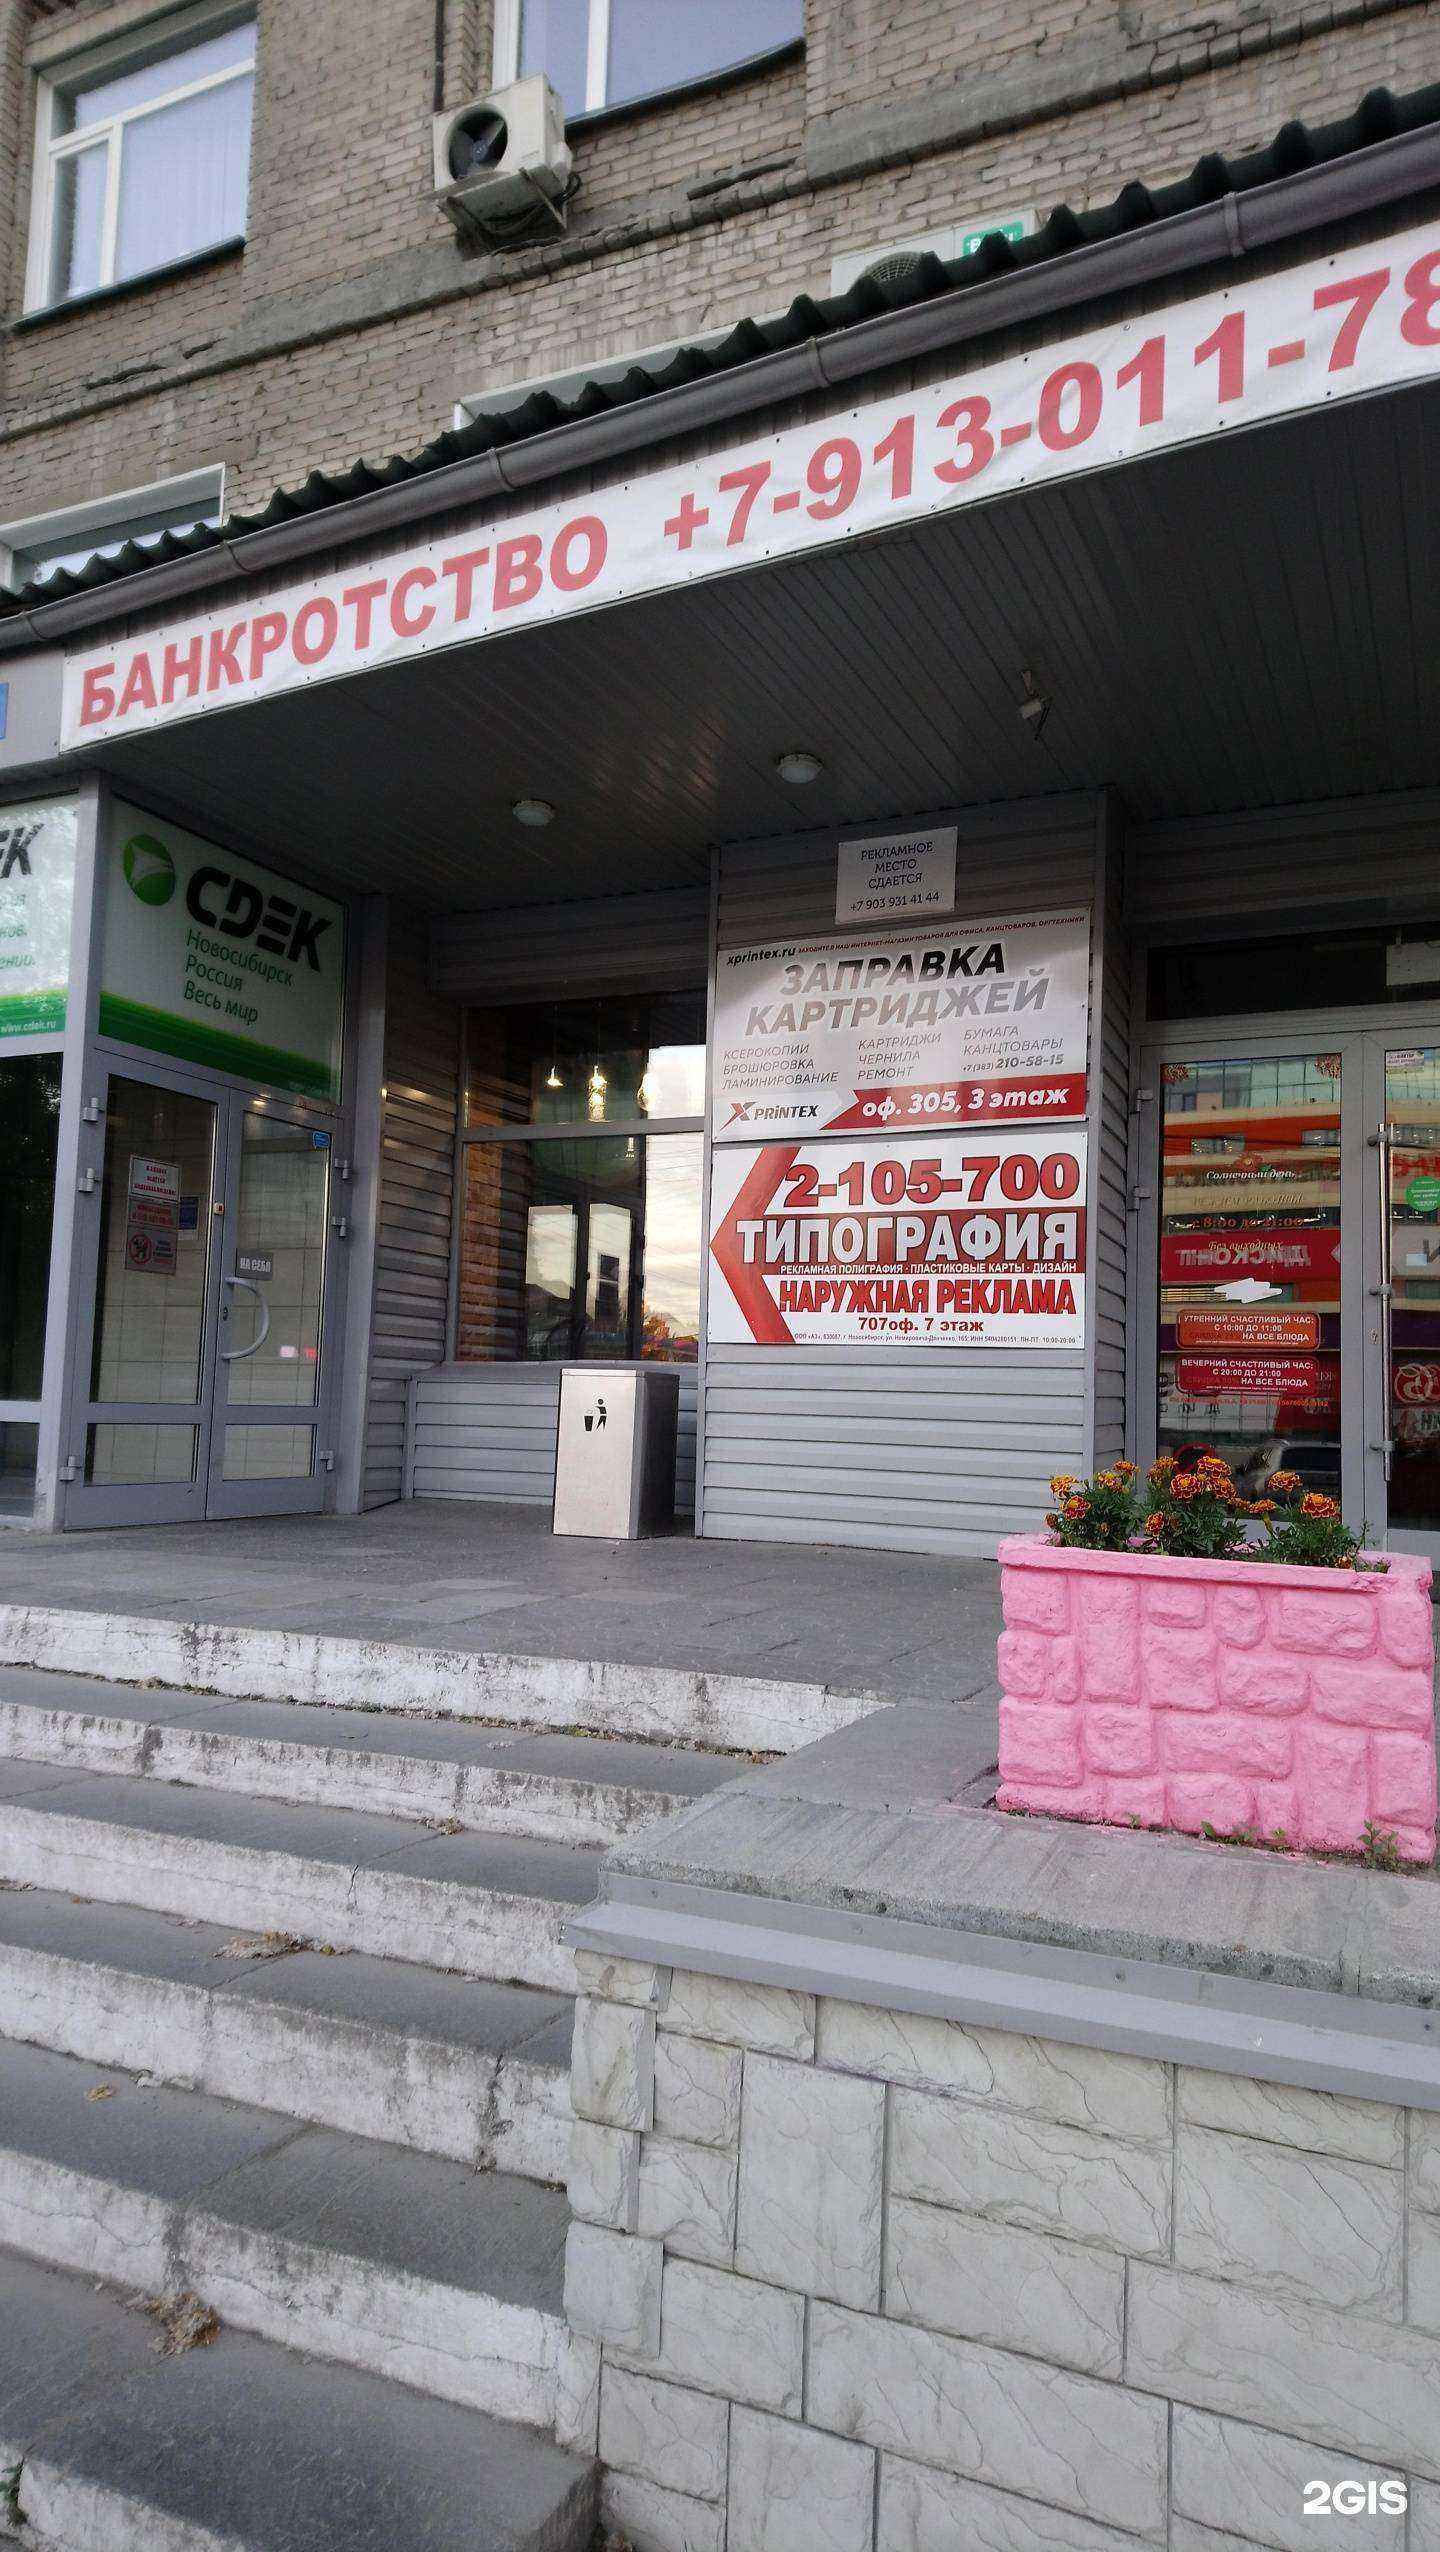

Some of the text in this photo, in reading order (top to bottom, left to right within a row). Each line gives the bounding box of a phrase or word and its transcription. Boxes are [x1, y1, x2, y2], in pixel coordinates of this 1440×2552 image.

[80, 516, 608, 727] БАНКРОТСТВО
[861, 842, 933, 860] РЕКЛАМНОЕ
[875, 859, 917, 873] МЕСТО
[869, 873, 922, 889] СДАЕТСЯ
[851, 892, 940, 911] +7 903 931 41 44
[186, 866, 332, 972] CDEK
[186, 928, 295, 987] Новосибирск
[727, 948, 797, 967] xprintex.ru
[186, 955, 243, 992] Россия
[780, 942, 1005, 996] ЗАПРАВКА
[184, 980, 259, 1027] Весь мир
[745, 968, 1051, 1036] КАРТРИДЖЕЙ
[858, 1031, 942, 1051] КАРТРИДЖИ
[964, 1025, 1019, 1040] БУМАГА
[724, 1043, 810, 1061] КСЕРОКОПИИ
[964, 1038, 1063, 1056] КАНЦТОВАРЫ
[858, 1050, 921, 1065] ЧЕРНИЛА
[996, 1054, 1064, 1068] 210-58-15
[724, 1059, 815, 1075] БРОШЮРОВКА
[857, 1066, 915, 1081] РЕМОНТ
[722, 1071, 839, 1089] ЛАМИНИРОВАНИЕ
[862, 1087, 1069, 1118] оф. 305, 3 этаж
[784, 1152, 1080, 1207] 2-105-700
[736, 1212, 1078, 1264] ТИПОГРАФИЯ
[780, 1261, 1077, 1274] РЕКЛАМНАЯ ПОЛИГРАФИЯ ПЛАСТИКОВЫЕ КАРТЫ ДИЗАЙН
[779, 1279, 1077, 1315] НАРУЖНАЯ РЕКЛАМА
[924, 1317, 934, 1331] 7
[940, 1321, 984, 1332] этаж
[1184, 1315, 1314, 1324] УТРЕННИЙ СЧАСТЛИВЫЙ ЧАС:
[1245, 1324, 1259, 1332] ДО
[1276, 1333, 1309, 1342] БЛЮДА
[1181, 1358, 1314, 1370] ВЕЧЕРНИЙ СЧАСТЛИВЫЙ ЧАС:
[1244, 1369, 1257, 1377] ДО
[1256, 1378, 1274, 1386] ВСЕ
[1275, 1379, 1308, 1387] БЛЮДА
